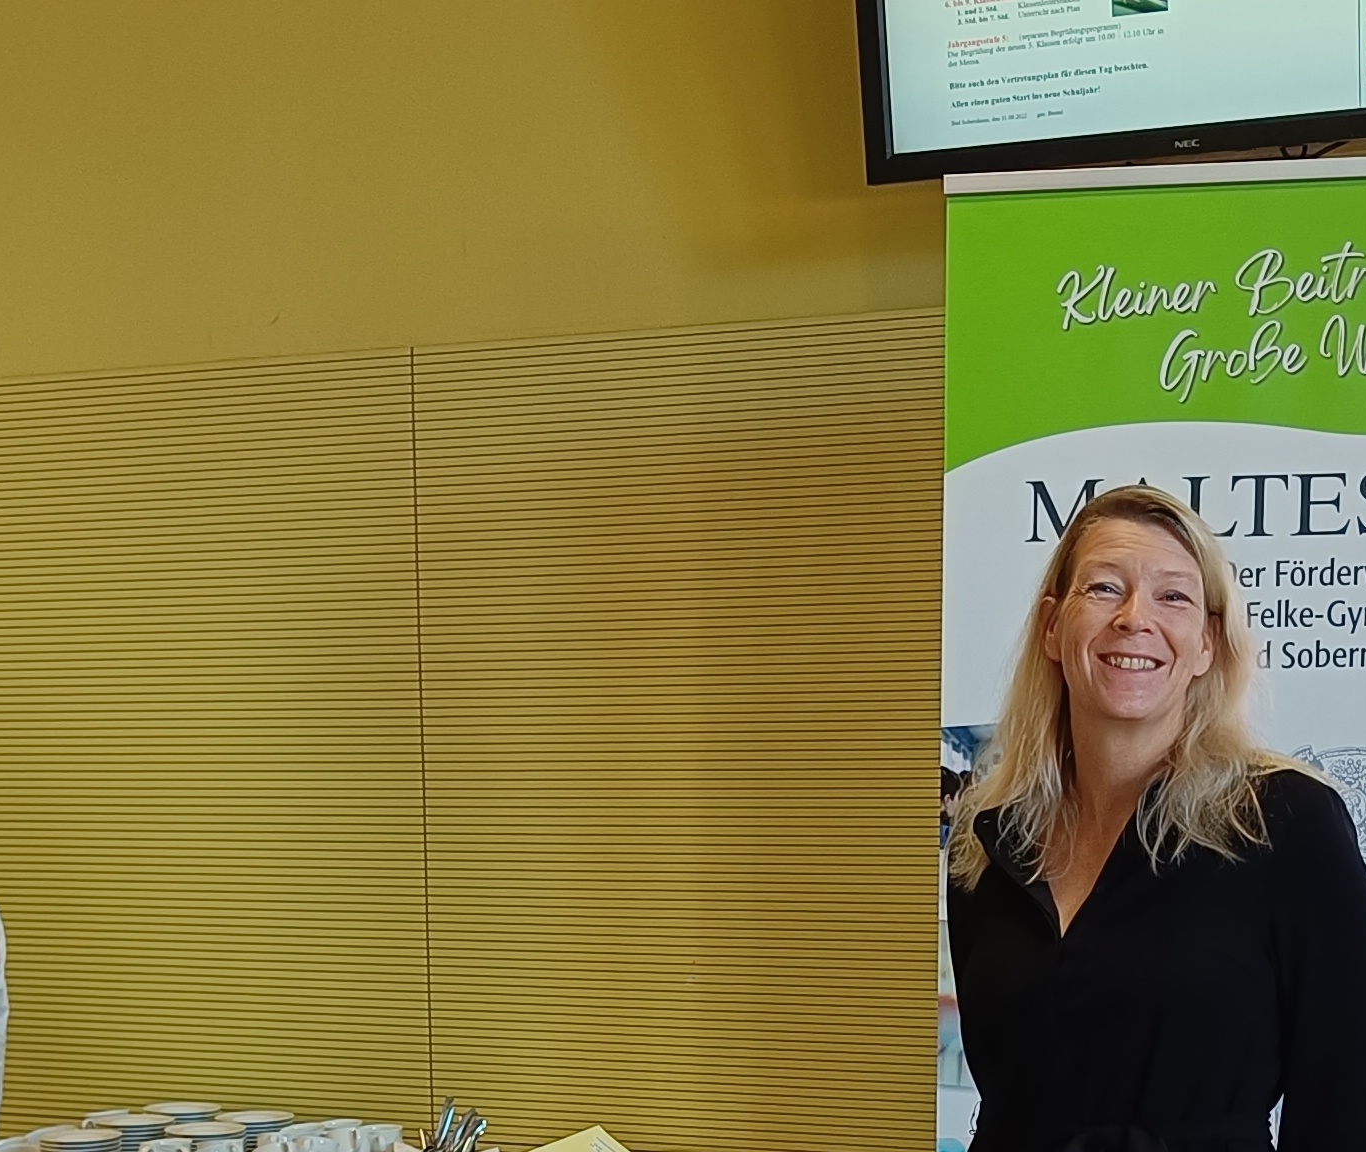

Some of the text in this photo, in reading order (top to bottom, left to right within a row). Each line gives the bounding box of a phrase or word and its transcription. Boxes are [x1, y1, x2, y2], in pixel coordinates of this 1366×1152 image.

[1098, 66, 1113, 75] Tag
[1114, 63, 1149, 72] beachten.
[1012, 94, 1030, 102] Start
[1174, 138, 1201, 149] NEC
[1056, 264, 1217, 332] Kleiner
[1158, 321, 1308, 404] Große
